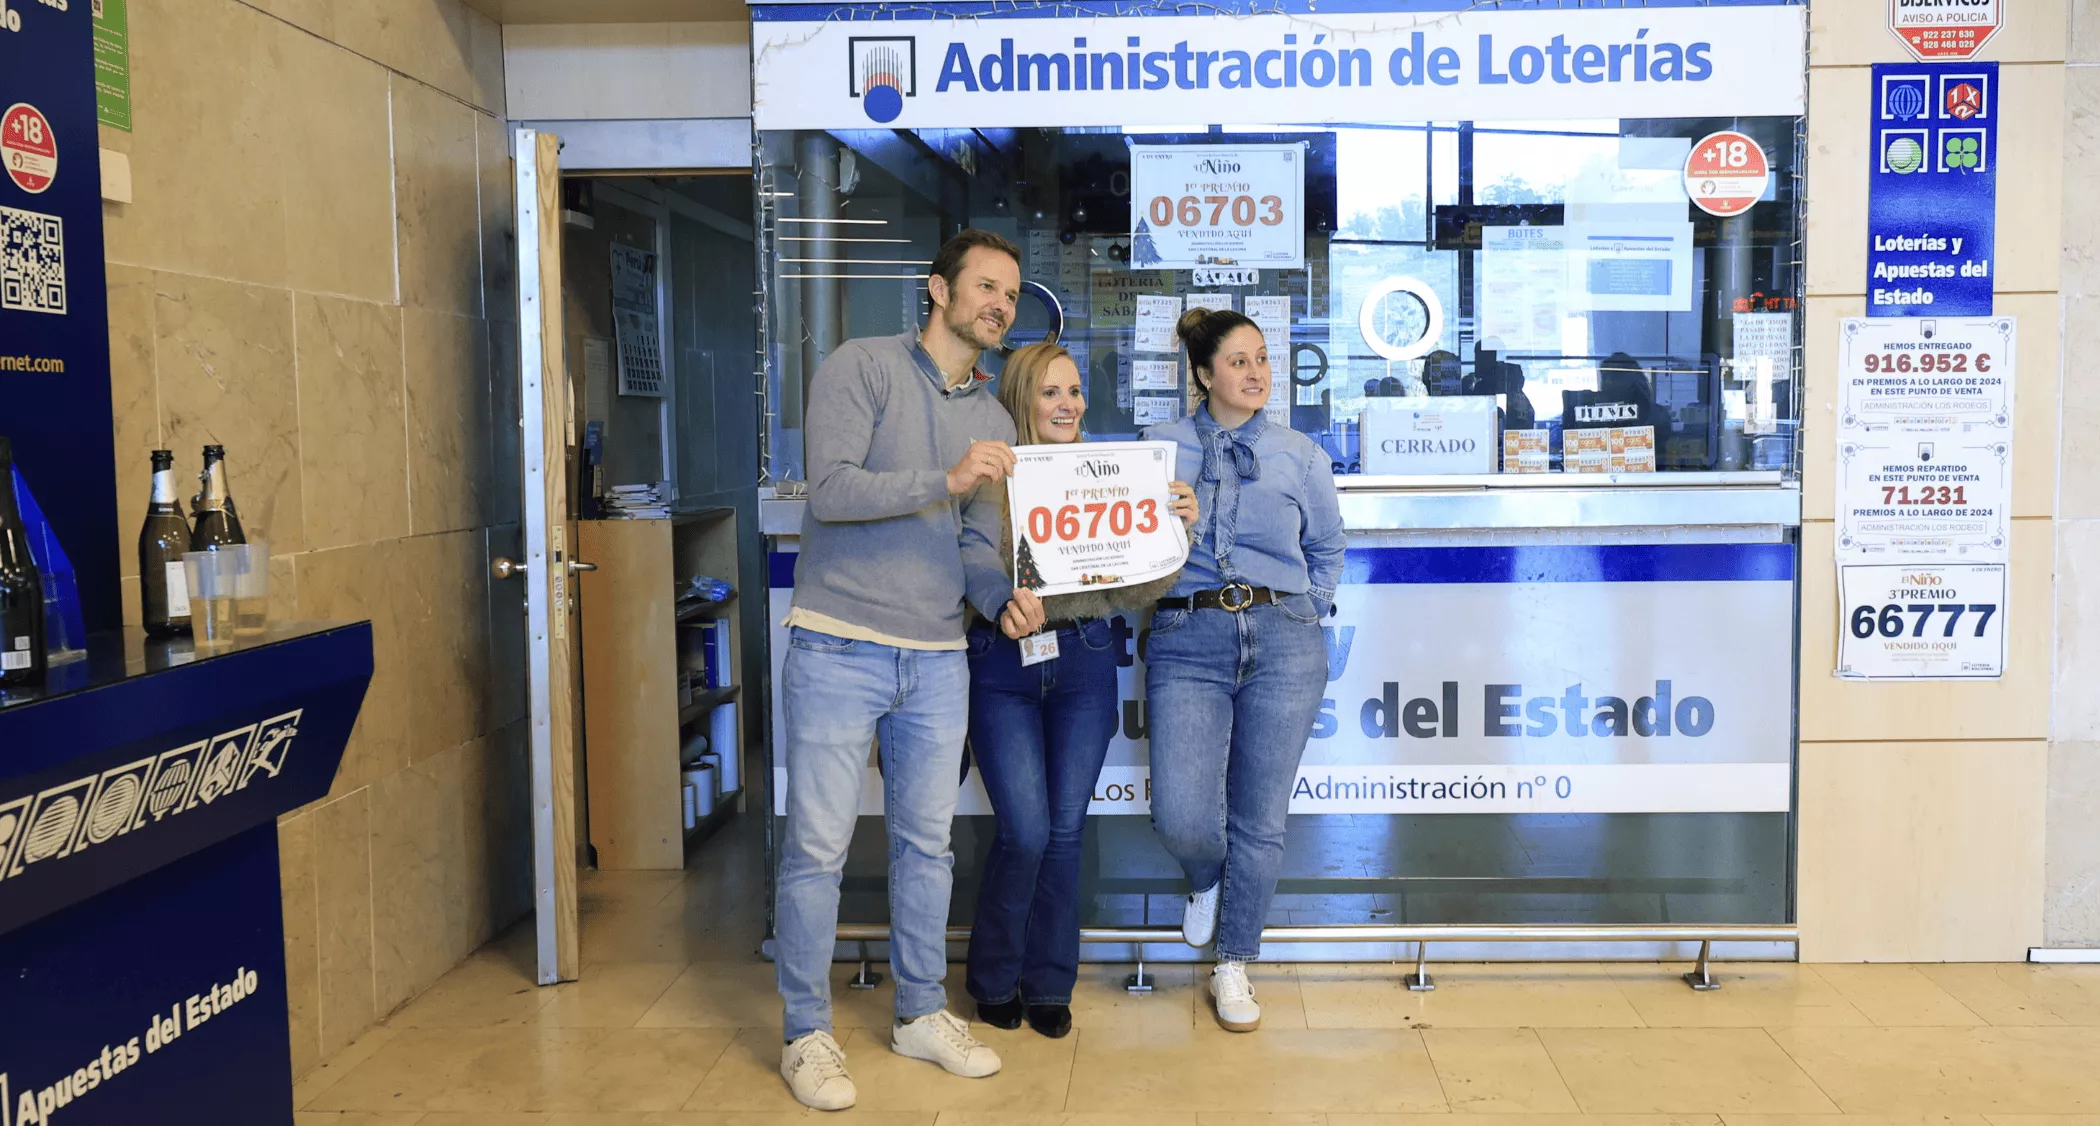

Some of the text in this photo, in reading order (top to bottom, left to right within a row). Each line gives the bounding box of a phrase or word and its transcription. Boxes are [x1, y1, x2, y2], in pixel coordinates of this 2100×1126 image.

[1902, 12, 1988, 23] AVISO A POLICIA
[1923, 30, 1975, 39] 922 237 630
[1923, 40, 1939, 49] 928
[1959, 40, 1975, 48] 028
[935, 28, 1713, 93] Administración de Loterías
[11, 114, 43, 144] +18
[1703, 141, 1748, 168] +18
[1202, 159, 1241, 175] Niño
[1200, 183, 1250, 194] PREMIO
[1149, 195, 1284, 227] 06703
[1177, 230, 1224, 238] VENDIDO
[1508, 229, 1543, 239] BOTES
[1875, 233, 1963, 255] Loterías y
[1873, 259, 1988, 283] Apuestas del
[1873, 287, 1933, 305] Estado
[1864, 353, 1991, 373] 916.952 €
[1954, 387, 1983, 395] VENTA
[1864, 400, 1933, 410] ADMINISTRACIÓN
[1935, 402, 1950, 410] LOS
[1380, 438, 1476, 454] CERRADO
[1566, 439, 1579, 447] 100
[1611, 438, 1624, 446] 100
[1082, 459, 1120, 478] Niño
[1081, 485, 1129, 500] PREMIO
[1881, 485, 1967, 505] 71.231
[1028, 498, 1159, 544] 06703
[1861, 521, 1984, 531] ADMINISTRACIÓN LOS RODEOS
[1057, 543, 1104, 555] VENDIDO
[1910, 573, 1943, 587] Niño
[1901, 588, 1957, 600] PREMIO
[1851, 603, 1997, 639] 66777
[1884, 642, 1929, 650] VENDIDO
[1360, 681, 1459, 739] del
[1483, 679, 1716, 738] Estado
[1091, 779, 1135, 802] Los
[1292, 774, 1572, 801] Administración nº 0
[16, 966, 258, 1126] Apuestas del Estado
